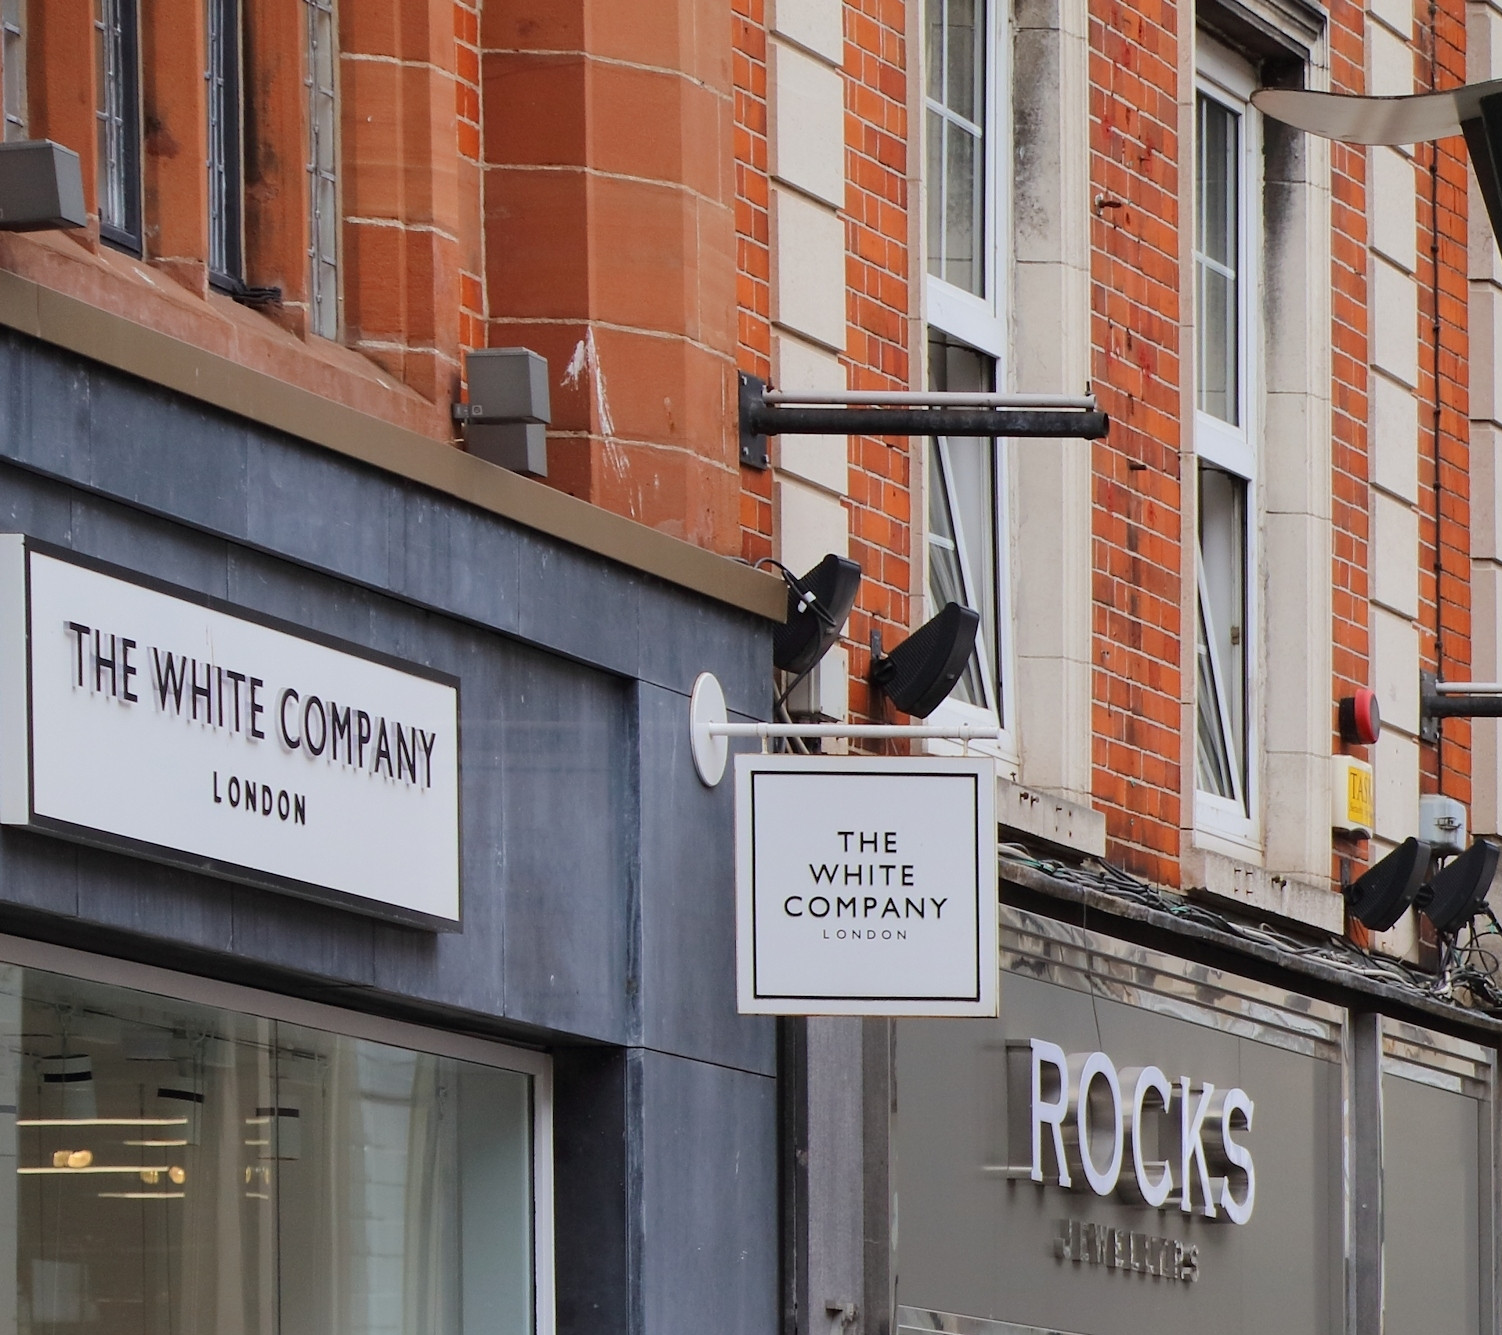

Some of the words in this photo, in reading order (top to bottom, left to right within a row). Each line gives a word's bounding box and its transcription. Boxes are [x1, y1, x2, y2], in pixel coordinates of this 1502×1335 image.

[66, 620, 139, 704] THE
[149, 646, 266, 742] WHITE
[278, 687, 437, 791] COMPANY
[213, 770, 306, 826] LONDON
[837, 831, 897, 853] THE
[809, 864, 914, 886] WHITE
[784, 896, 948, 919] COMPANY
[823, 929, 908, 940] LONDON
[1030, 1038, 1256, 1225] ROCKS
